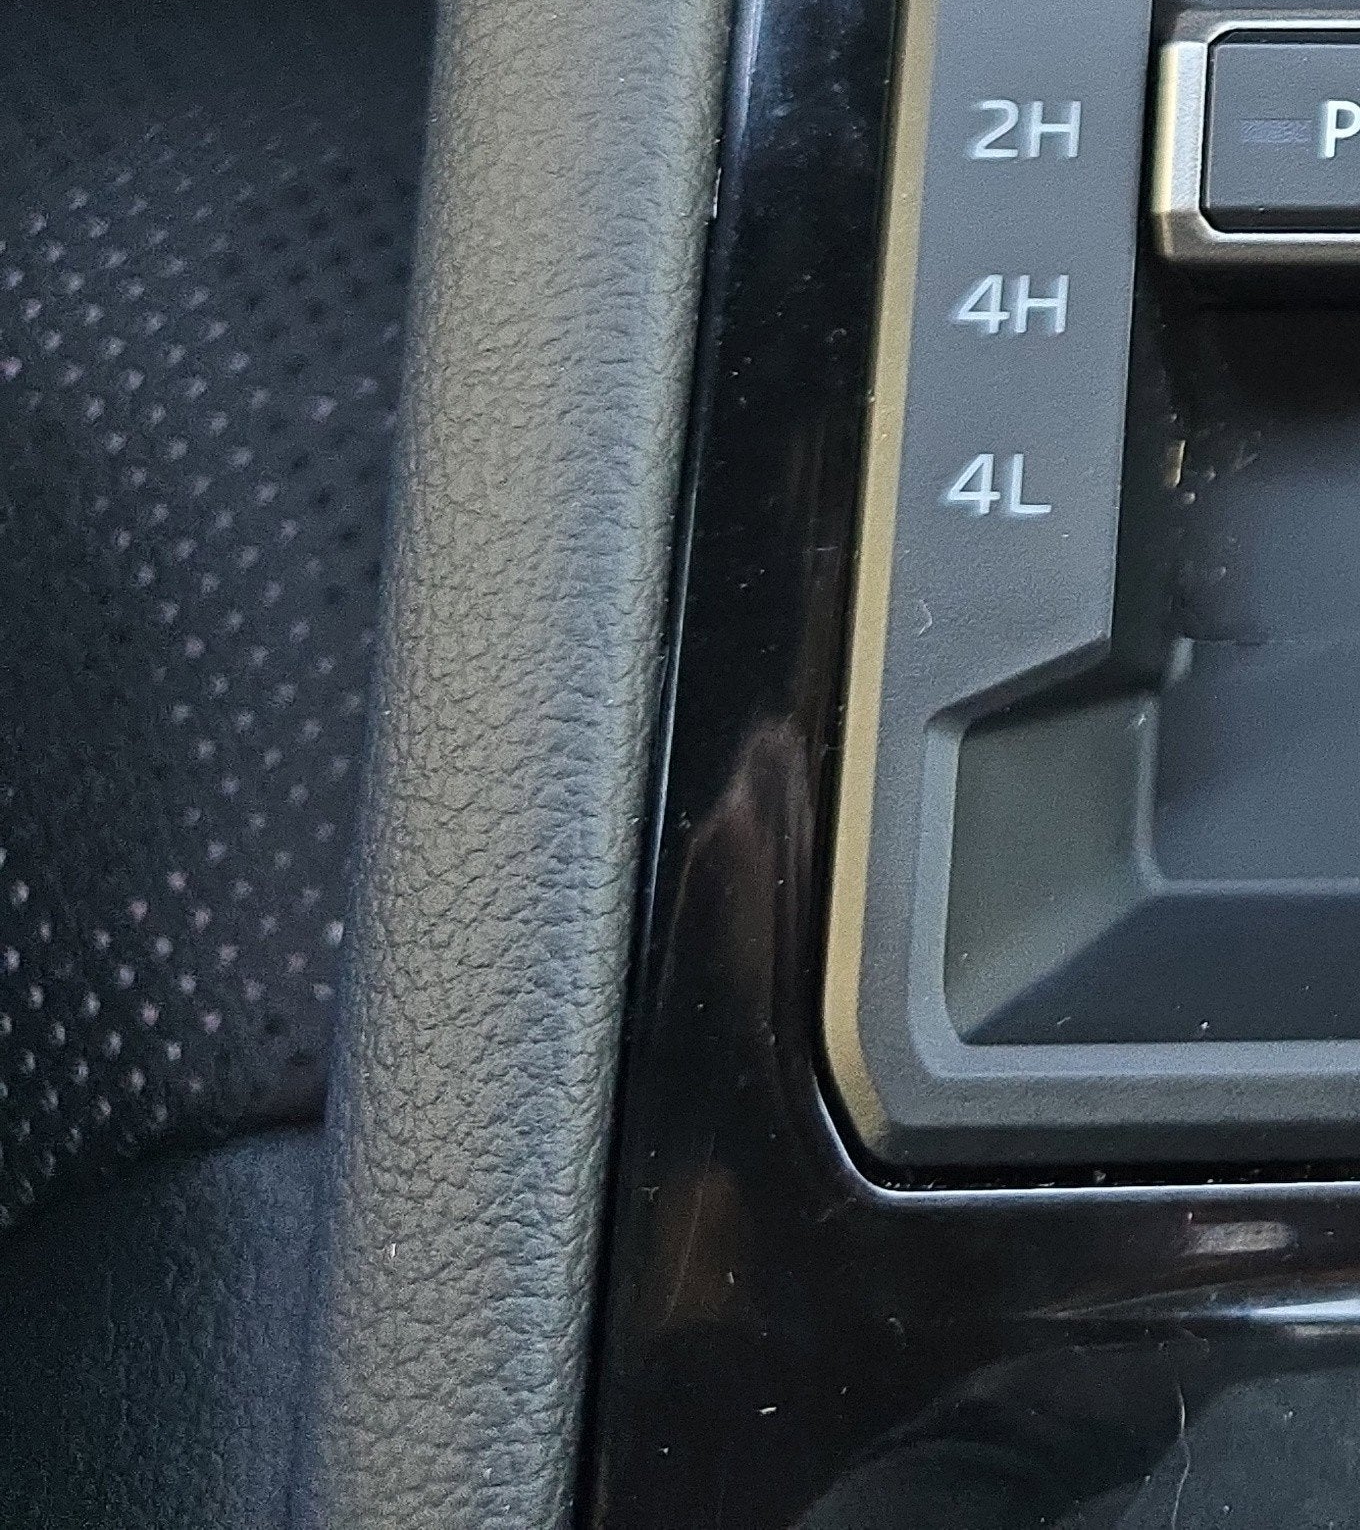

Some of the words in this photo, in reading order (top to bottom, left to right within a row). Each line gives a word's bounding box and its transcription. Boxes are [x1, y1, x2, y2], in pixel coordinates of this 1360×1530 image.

[968, 100, 1082, 159] 2H
[949, 274, 1069, 334] 4H
[941, 454, 1051, 515] 4L
